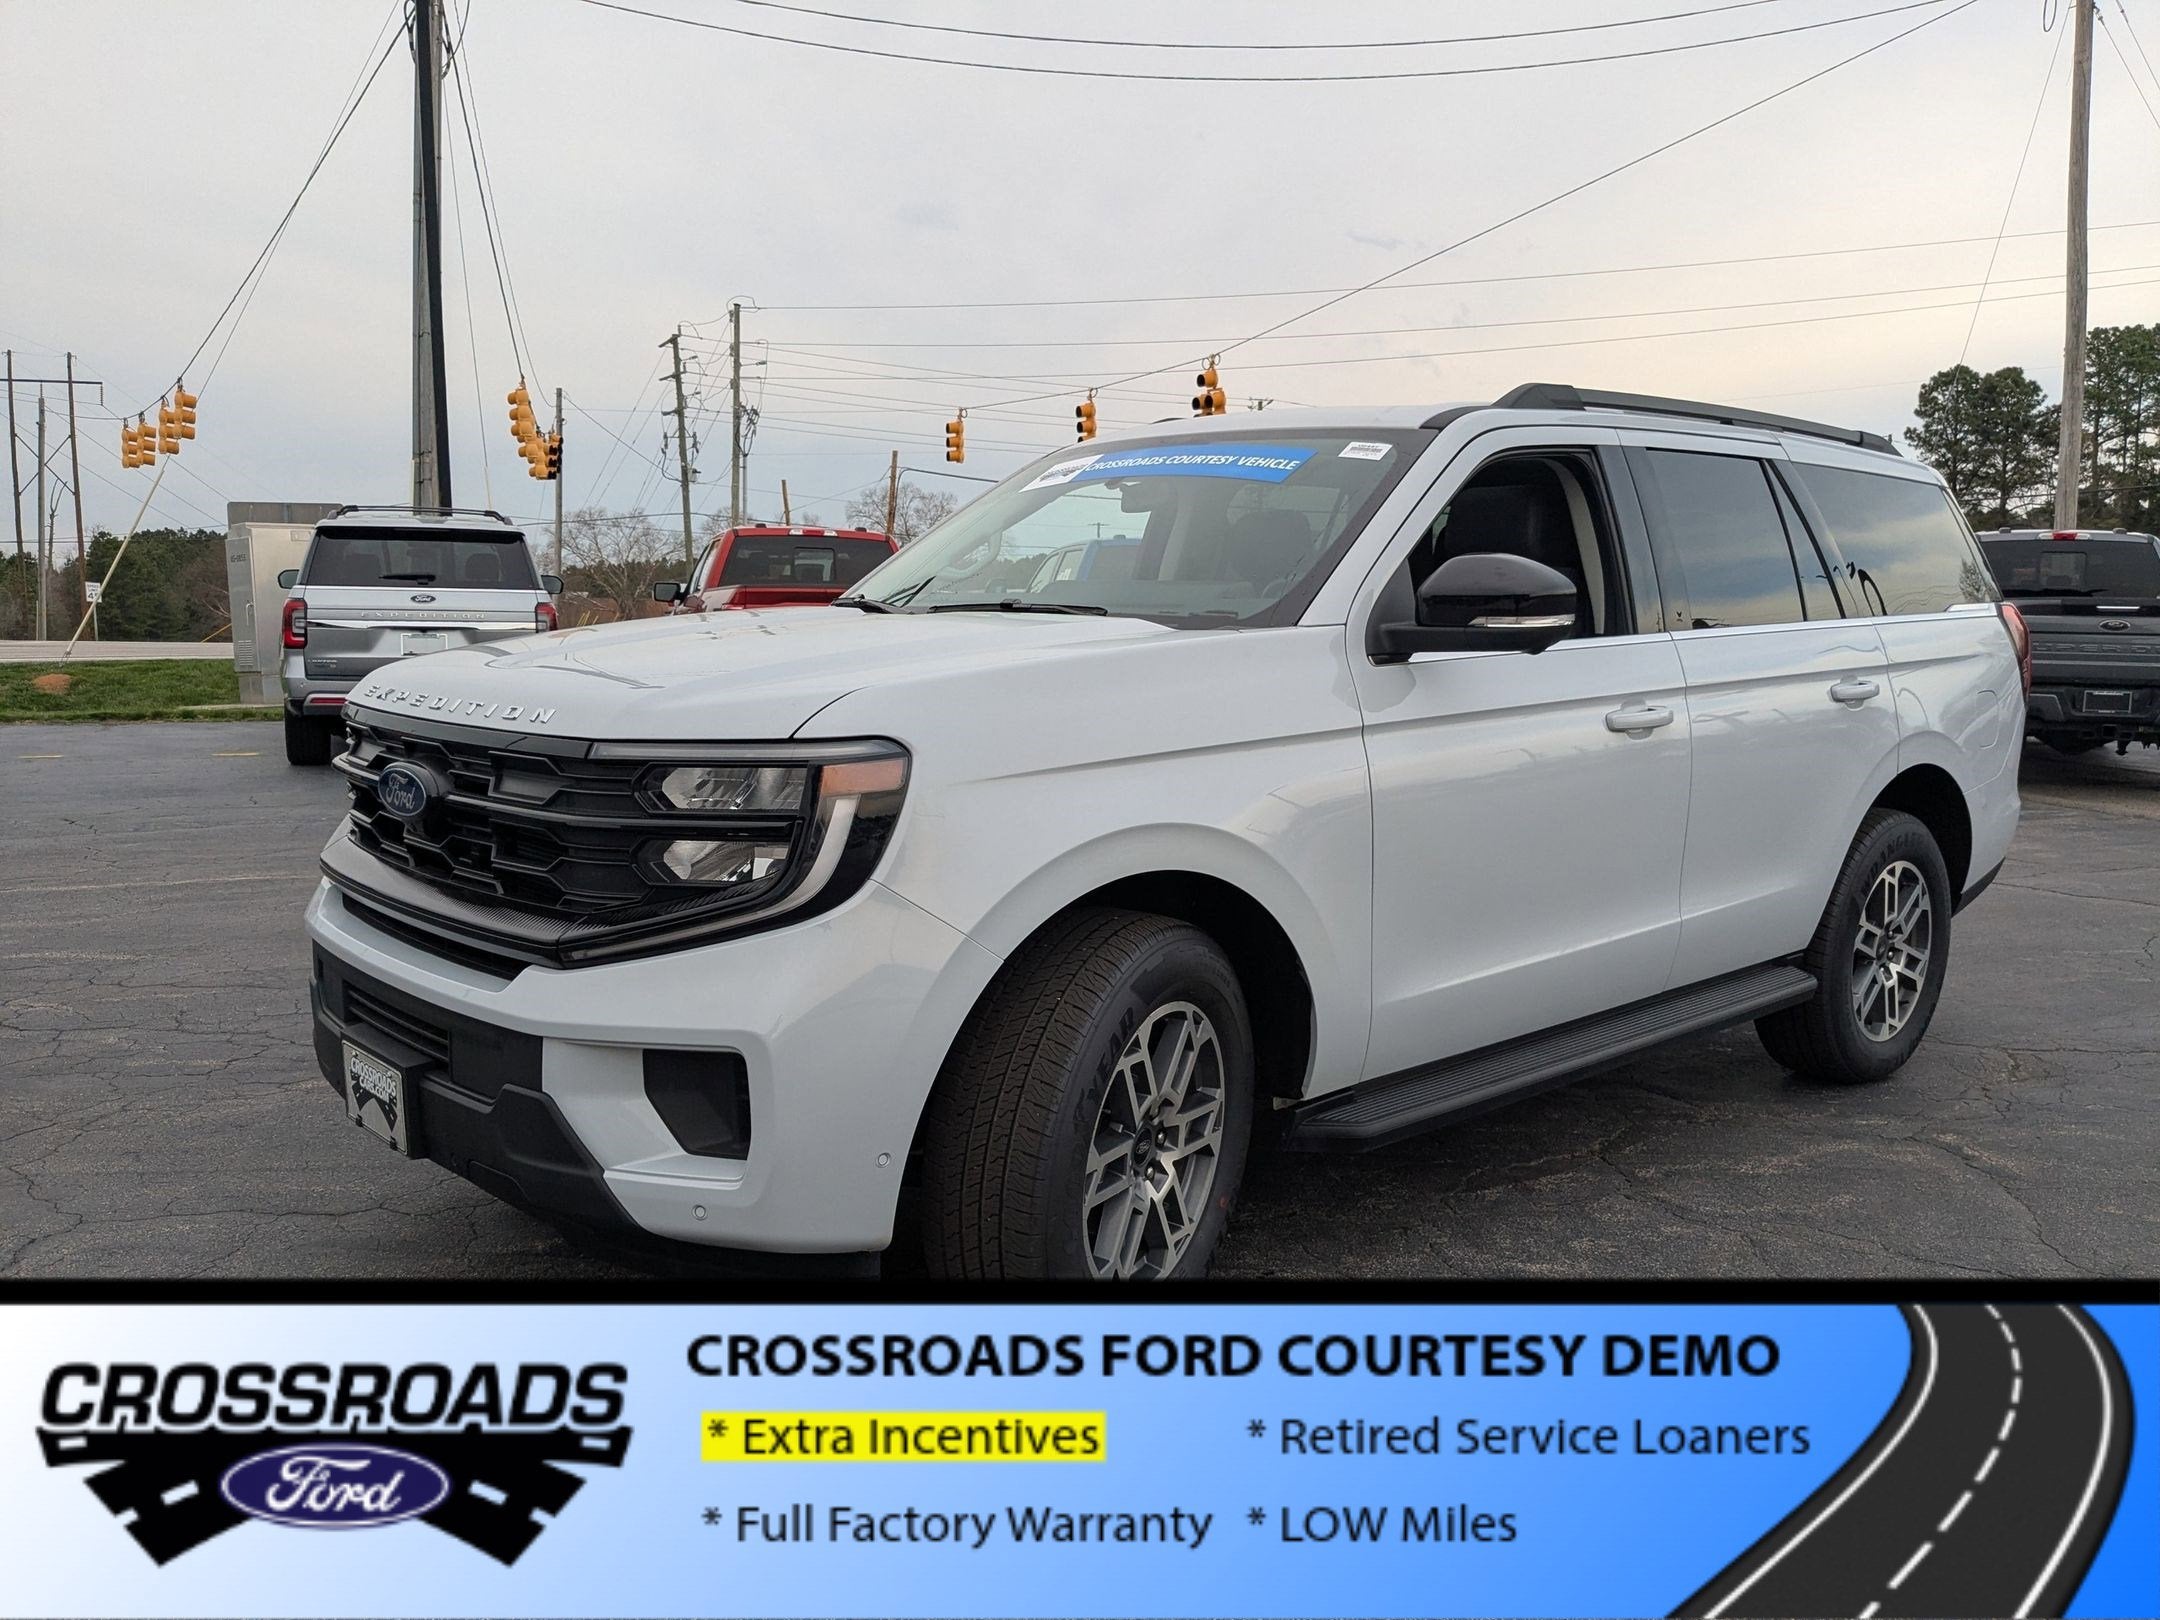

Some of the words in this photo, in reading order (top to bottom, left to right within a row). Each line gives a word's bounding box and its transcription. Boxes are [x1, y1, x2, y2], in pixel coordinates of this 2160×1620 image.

[1166, 455, 1238, 465] COURTESY
[1237, 456, 1301, 470] VEHICLE
[361, 612, 485, 620] EXPEDITION
[364, 685, 557, 724] EXPEDITION
[385, 772, 416, 810] Ford
[350, 1057, 397, 1097] CROSSROADS
